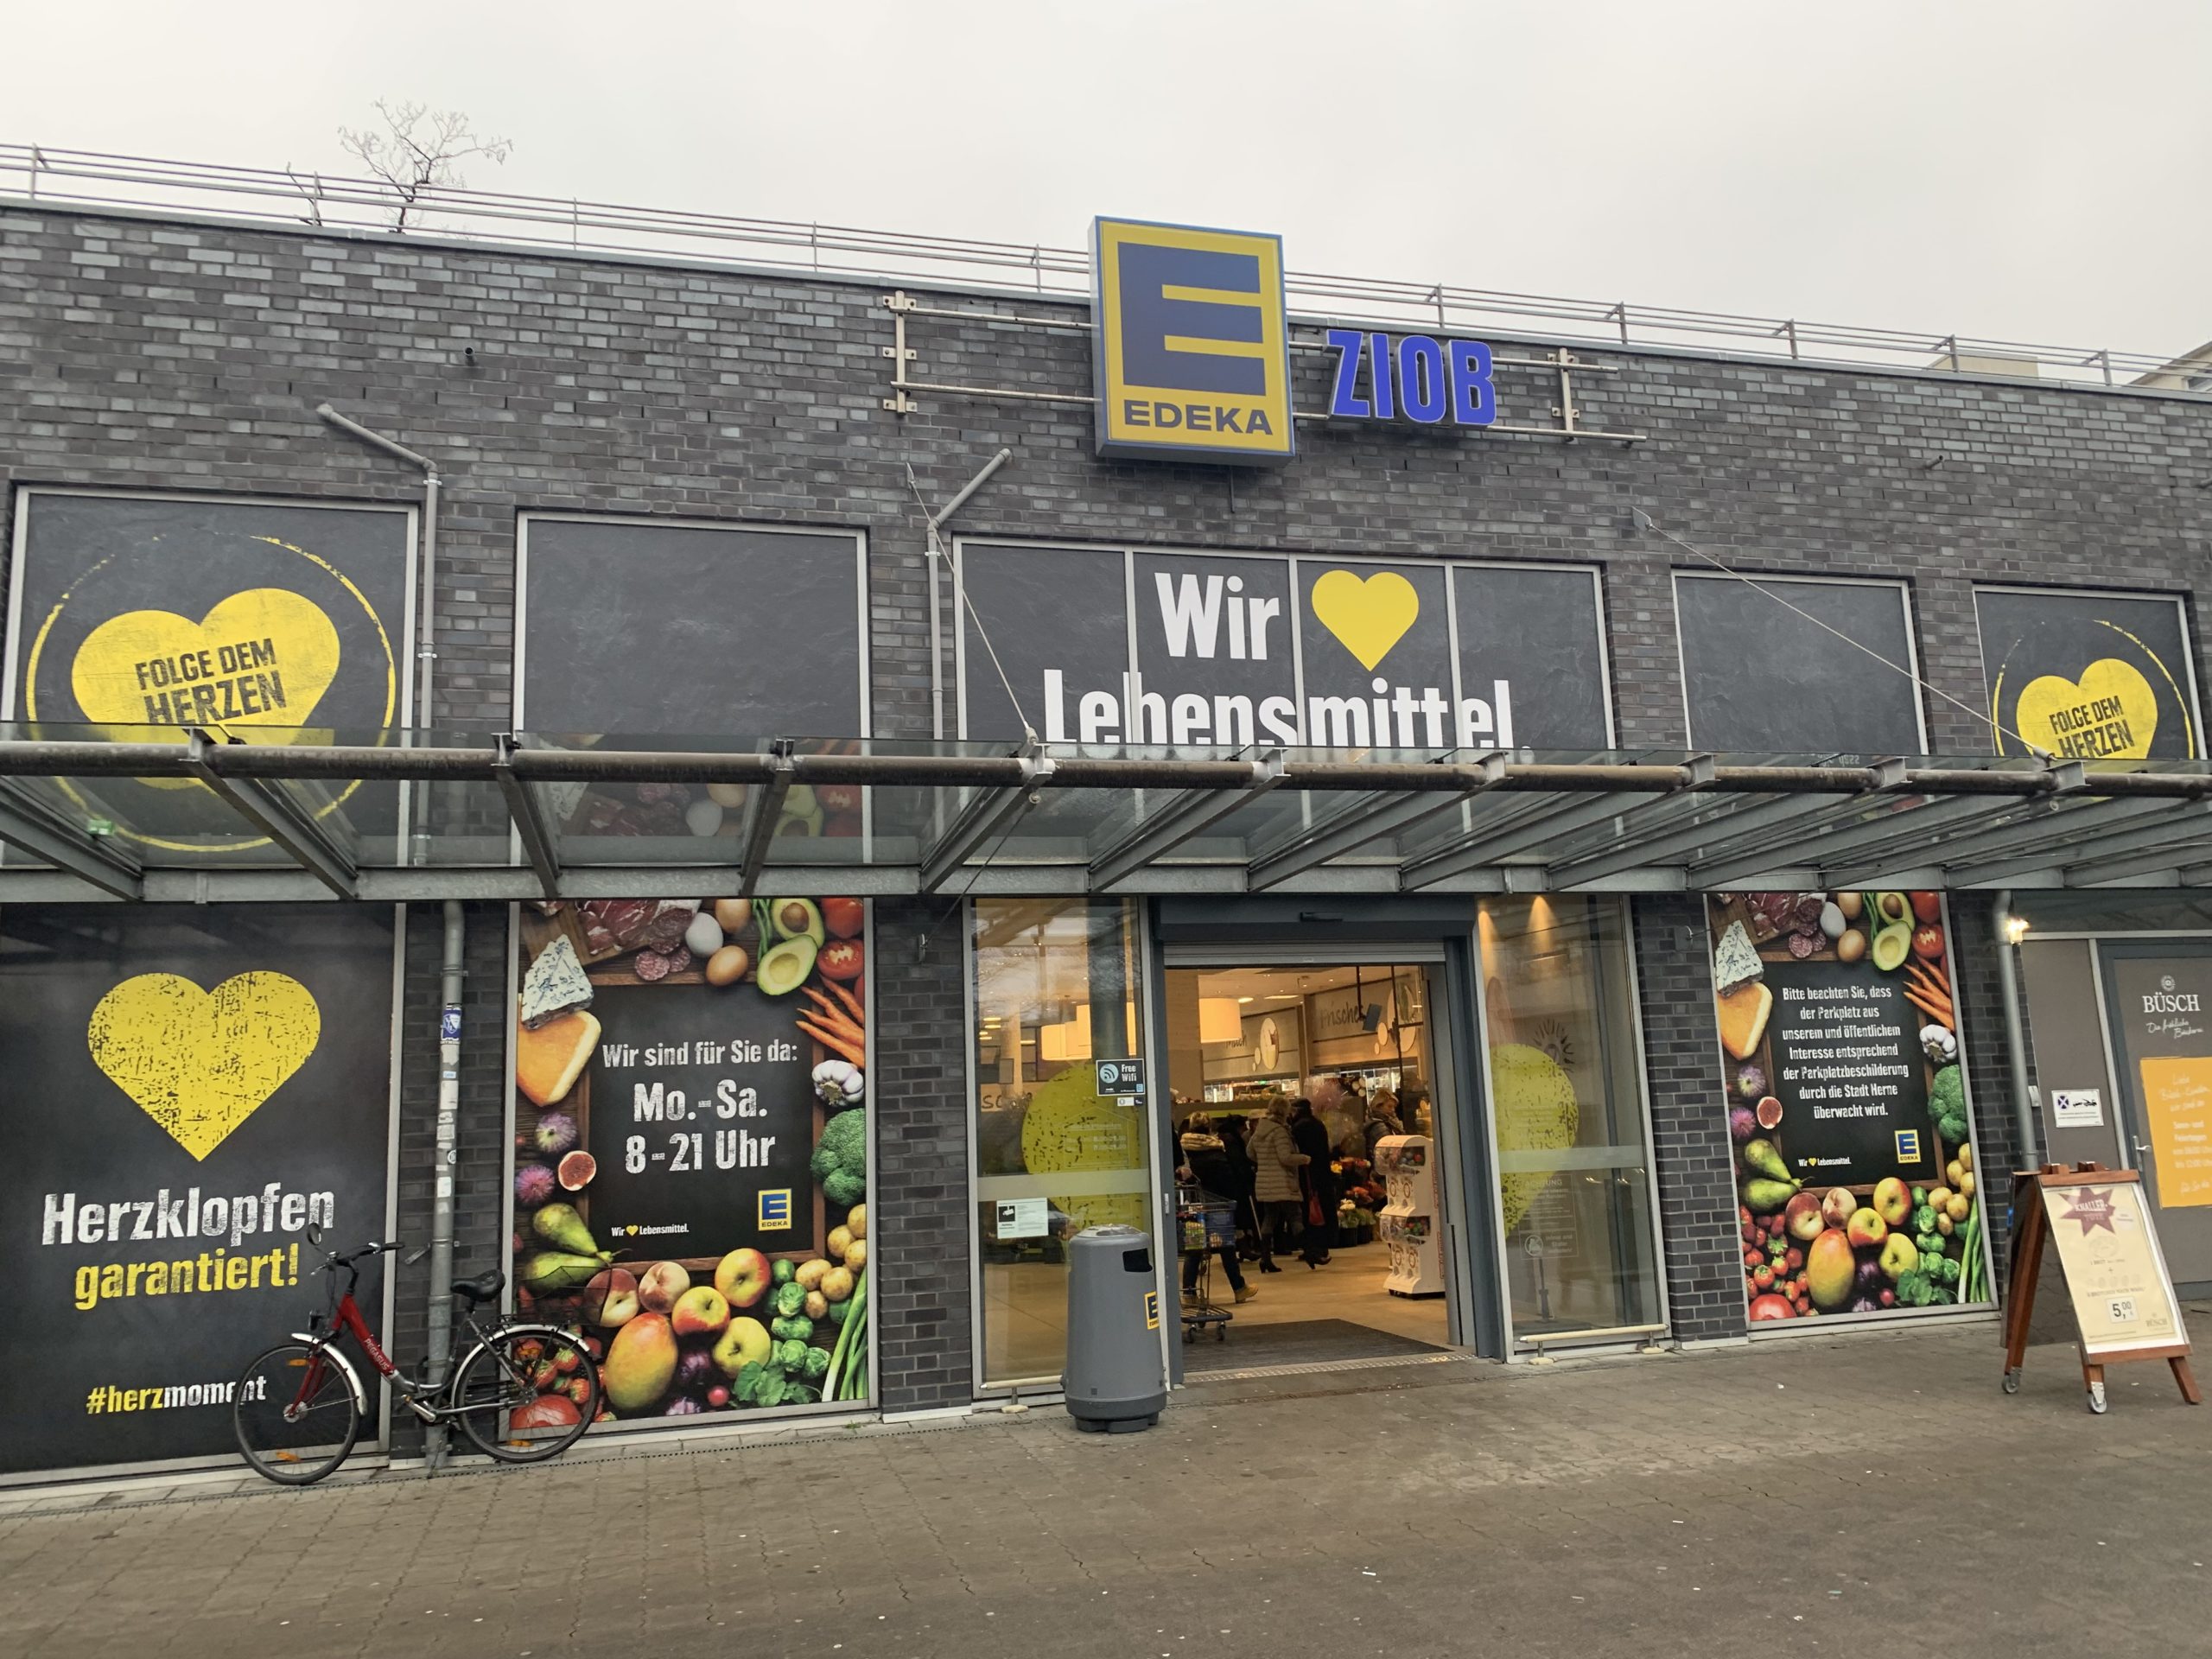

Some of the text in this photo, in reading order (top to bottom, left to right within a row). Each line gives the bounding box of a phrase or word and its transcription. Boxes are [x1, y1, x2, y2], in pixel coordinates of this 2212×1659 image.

[1325, 328, 1497, 427] ZIOB
[1123, 398, 1273, 436] EDEKA
[1154, 572, 1280, 660] Wir
[135, 638, 277, 690] FOLGE DEM
[143, 671, 288, 726] HERZEN
[2048, 696, 2124, 735] FOLGE DEM
[2057, 719, 2136, 759] HERZEN
[1782, 985, 1892, 1001] Bitte beachten Sie, dass
[2142, 991, 2201, 1014] BÜSCH
[1800, 1006, 1880, 1021] der Parkplatz aus
[1782, 1024, 1901, 1040] unserem und öffentlichem
[602, 1039, 798, 1068] Wir sind für Sie da:
[1789, 1043, 1898, 1060] Interesse entsprechend
[1121, 1064, 1136, 1073] Free
[1122, 1072, 1137, 1082] Wifi
[1783, 1063, 1910, 1081] der Parkplatzbeschilderung
[1799, 1083, 1898, 1100] durch die Stadt Herne
[1814, 1103, 1889, 1119] überwacht wird.
[715, 1129, 776, 1170] Uhr
[42, 1182, 334, 1247] Herzklopfen
[611, 1224, 690, 1237] Wir Lebensmittel.
[74, 1243, 298, 1310] garantiert!
